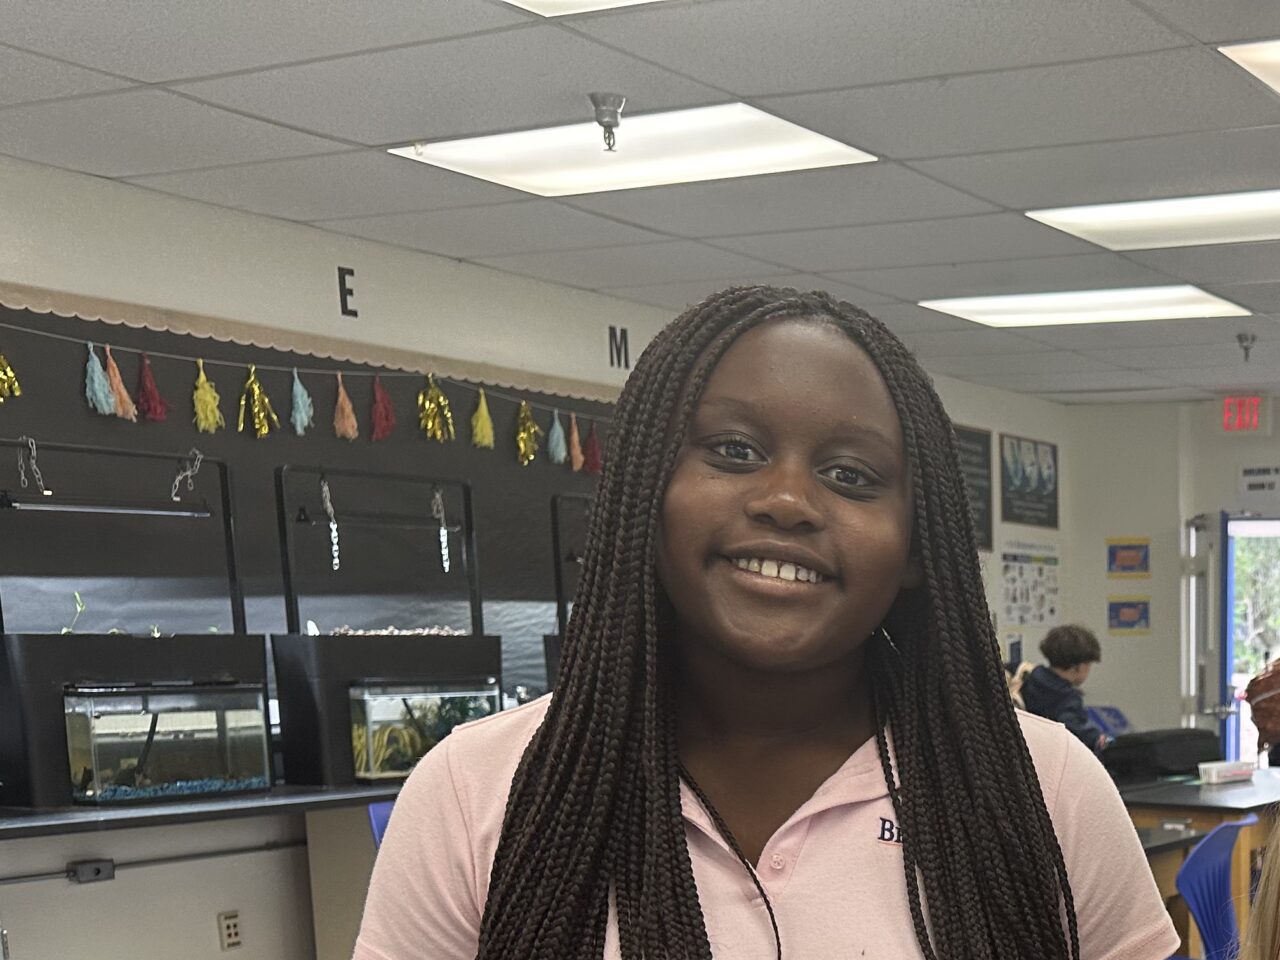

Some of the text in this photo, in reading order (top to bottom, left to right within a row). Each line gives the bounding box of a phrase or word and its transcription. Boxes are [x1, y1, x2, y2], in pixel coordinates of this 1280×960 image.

[337, 266, 630, 369] E M
[1223, 397, 1262, 432] EXIT
